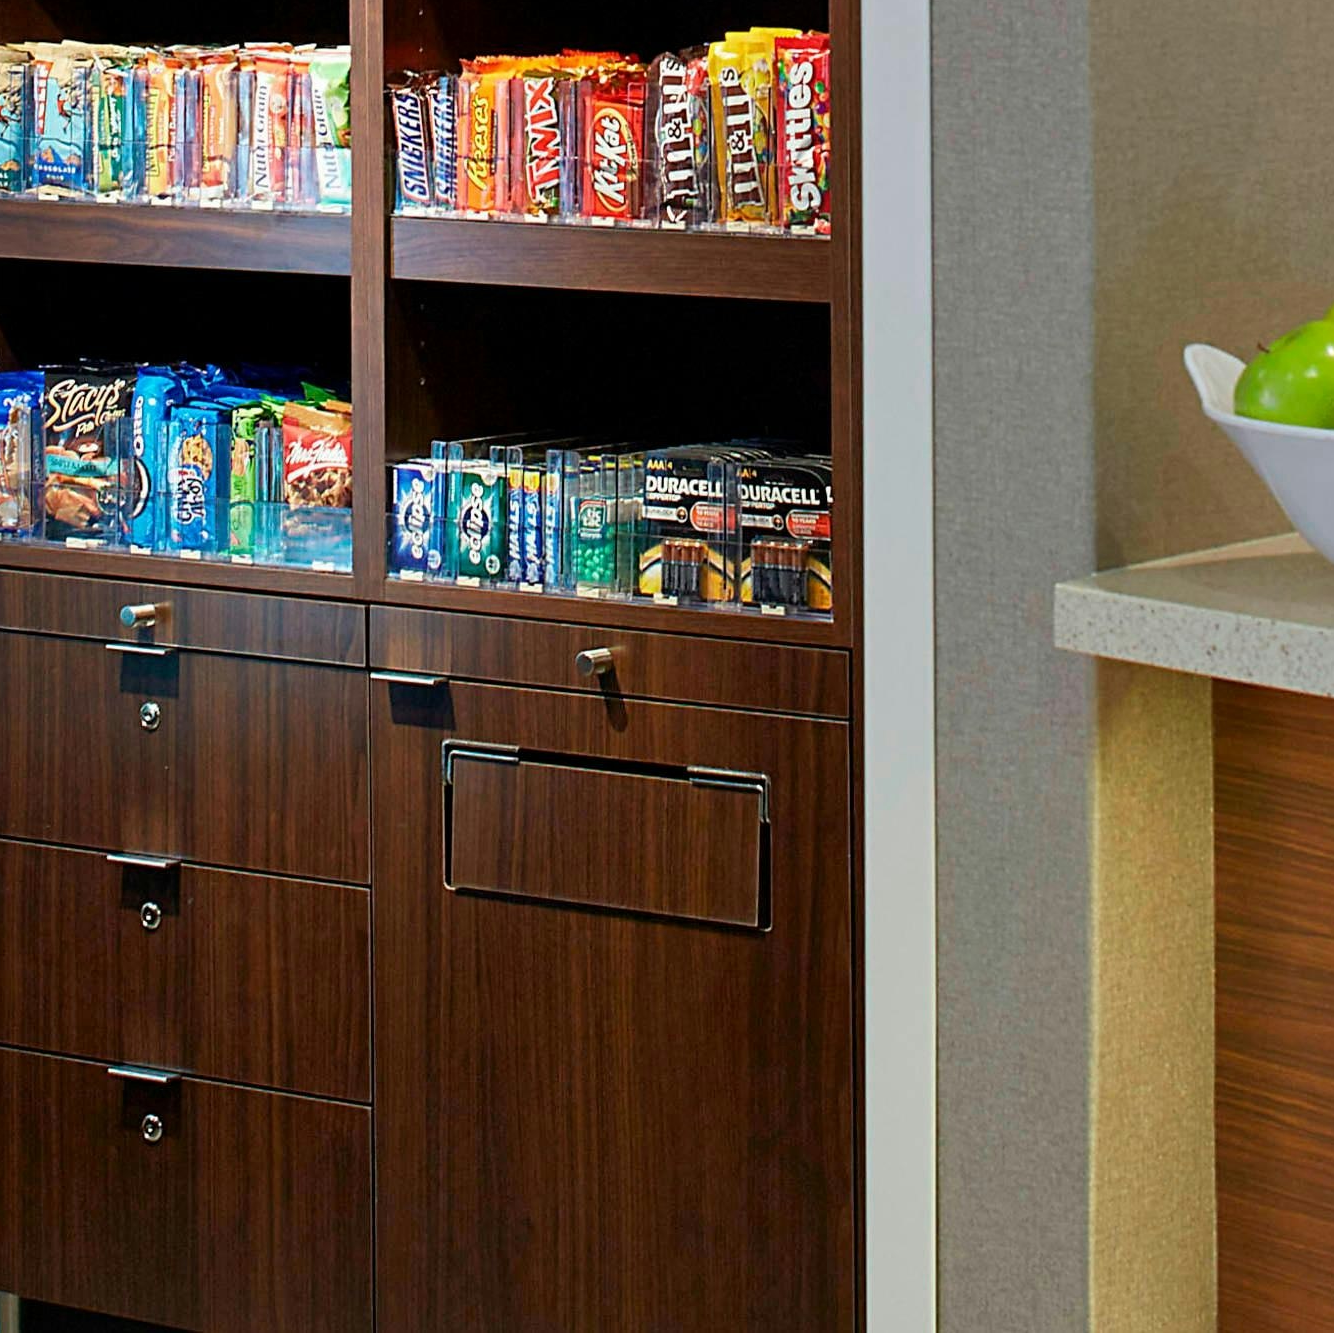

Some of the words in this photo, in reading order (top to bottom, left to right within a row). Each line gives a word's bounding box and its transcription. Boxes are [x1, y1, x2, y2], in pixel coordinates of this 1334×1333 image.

[396, 92, 428, 197] SNICKERS
[465, 95, 489, 191] Reese's
[526, 77, 562, 202] TWIX
[43, 378, 126, 432] Stacy's
[407, 477, 426, 560] eclipse
[465, 482, 484, 565] eclipse
[645, 474, 725, 498] DURACELL
[737, 483, 821, 506] DURACELL
